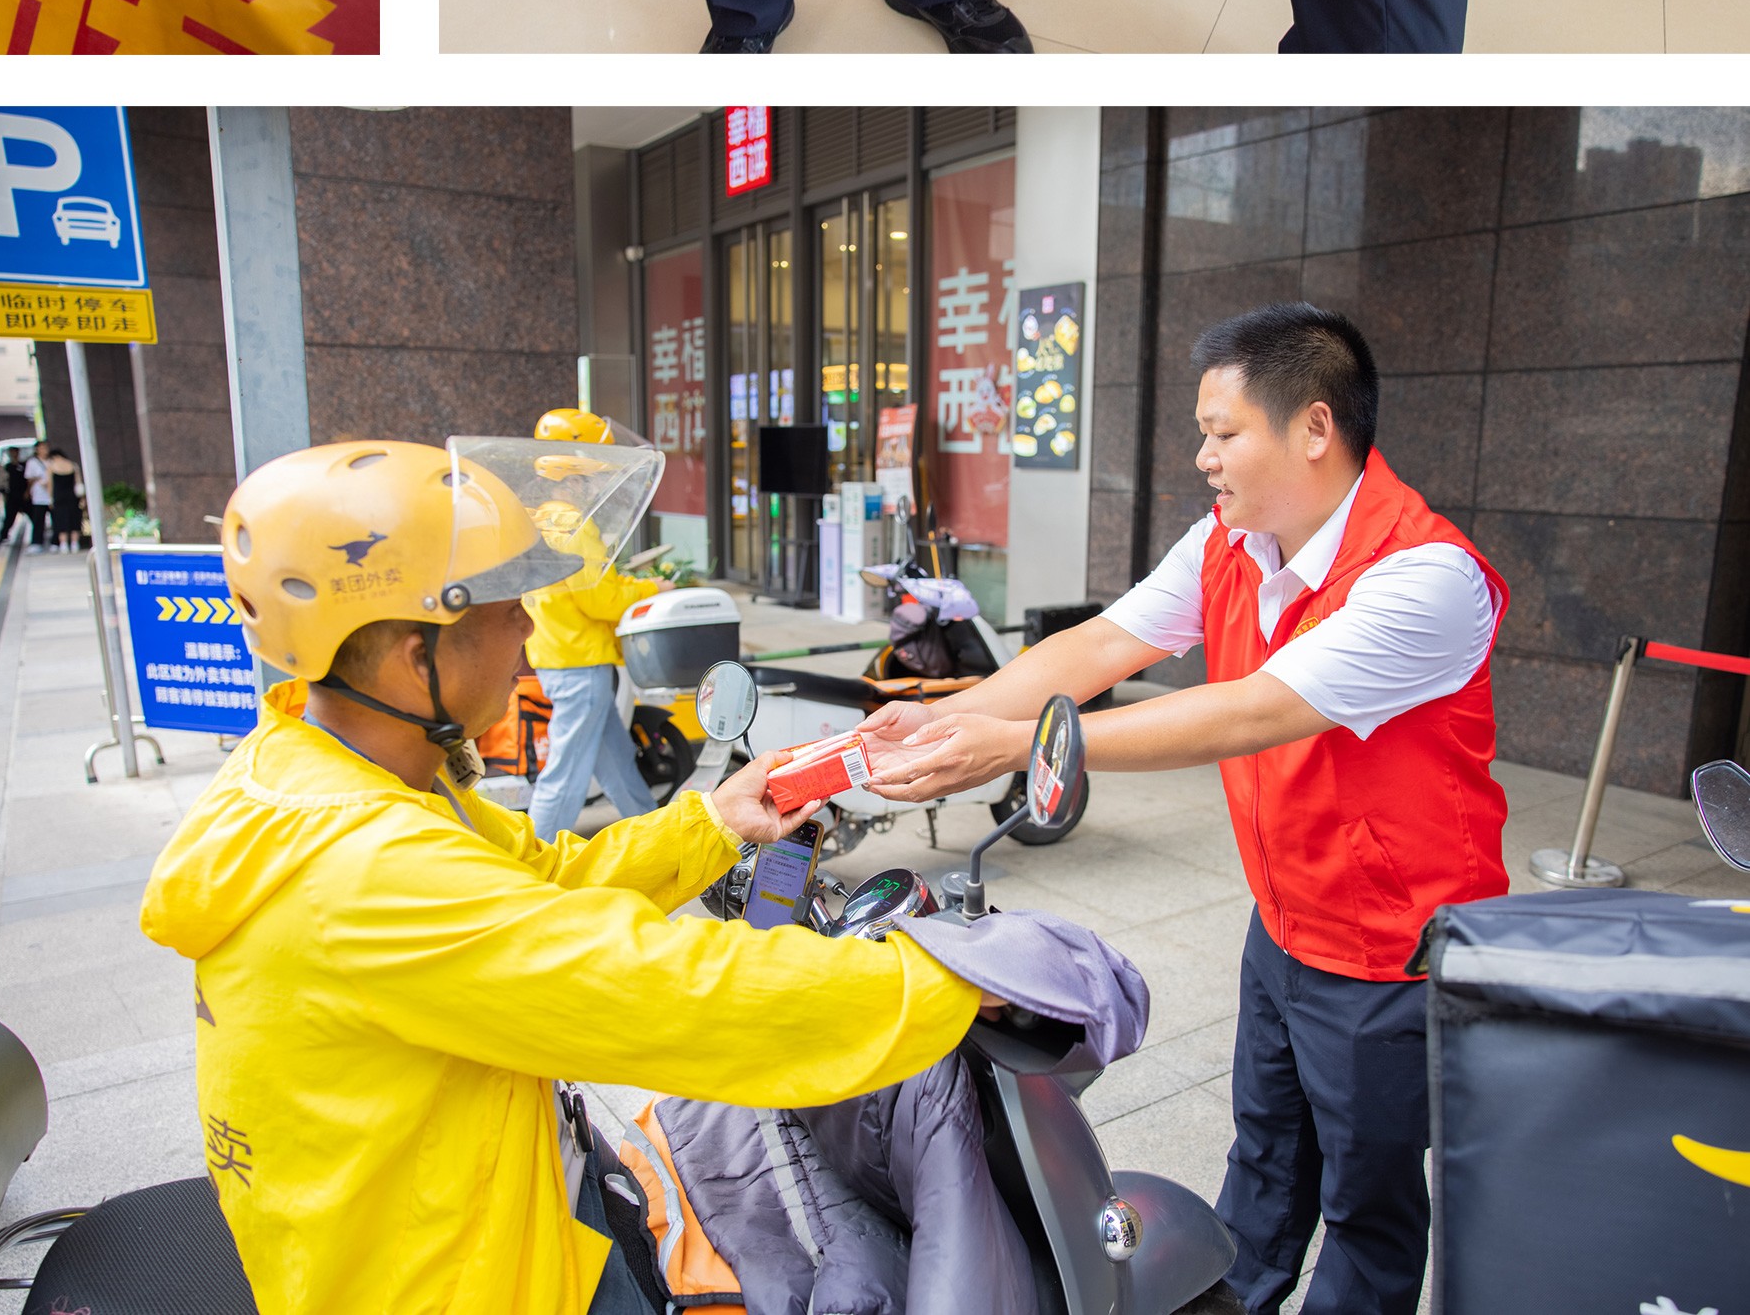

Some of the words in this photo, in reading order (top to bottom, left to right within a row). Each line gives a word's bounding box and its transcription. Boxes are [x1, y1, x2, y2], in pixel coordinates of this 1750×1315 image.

[1, 293, 137, 313] 临时停车
[5, 313, 139, 333] 即停即走
[652, 316, 706, 385] 幸福
